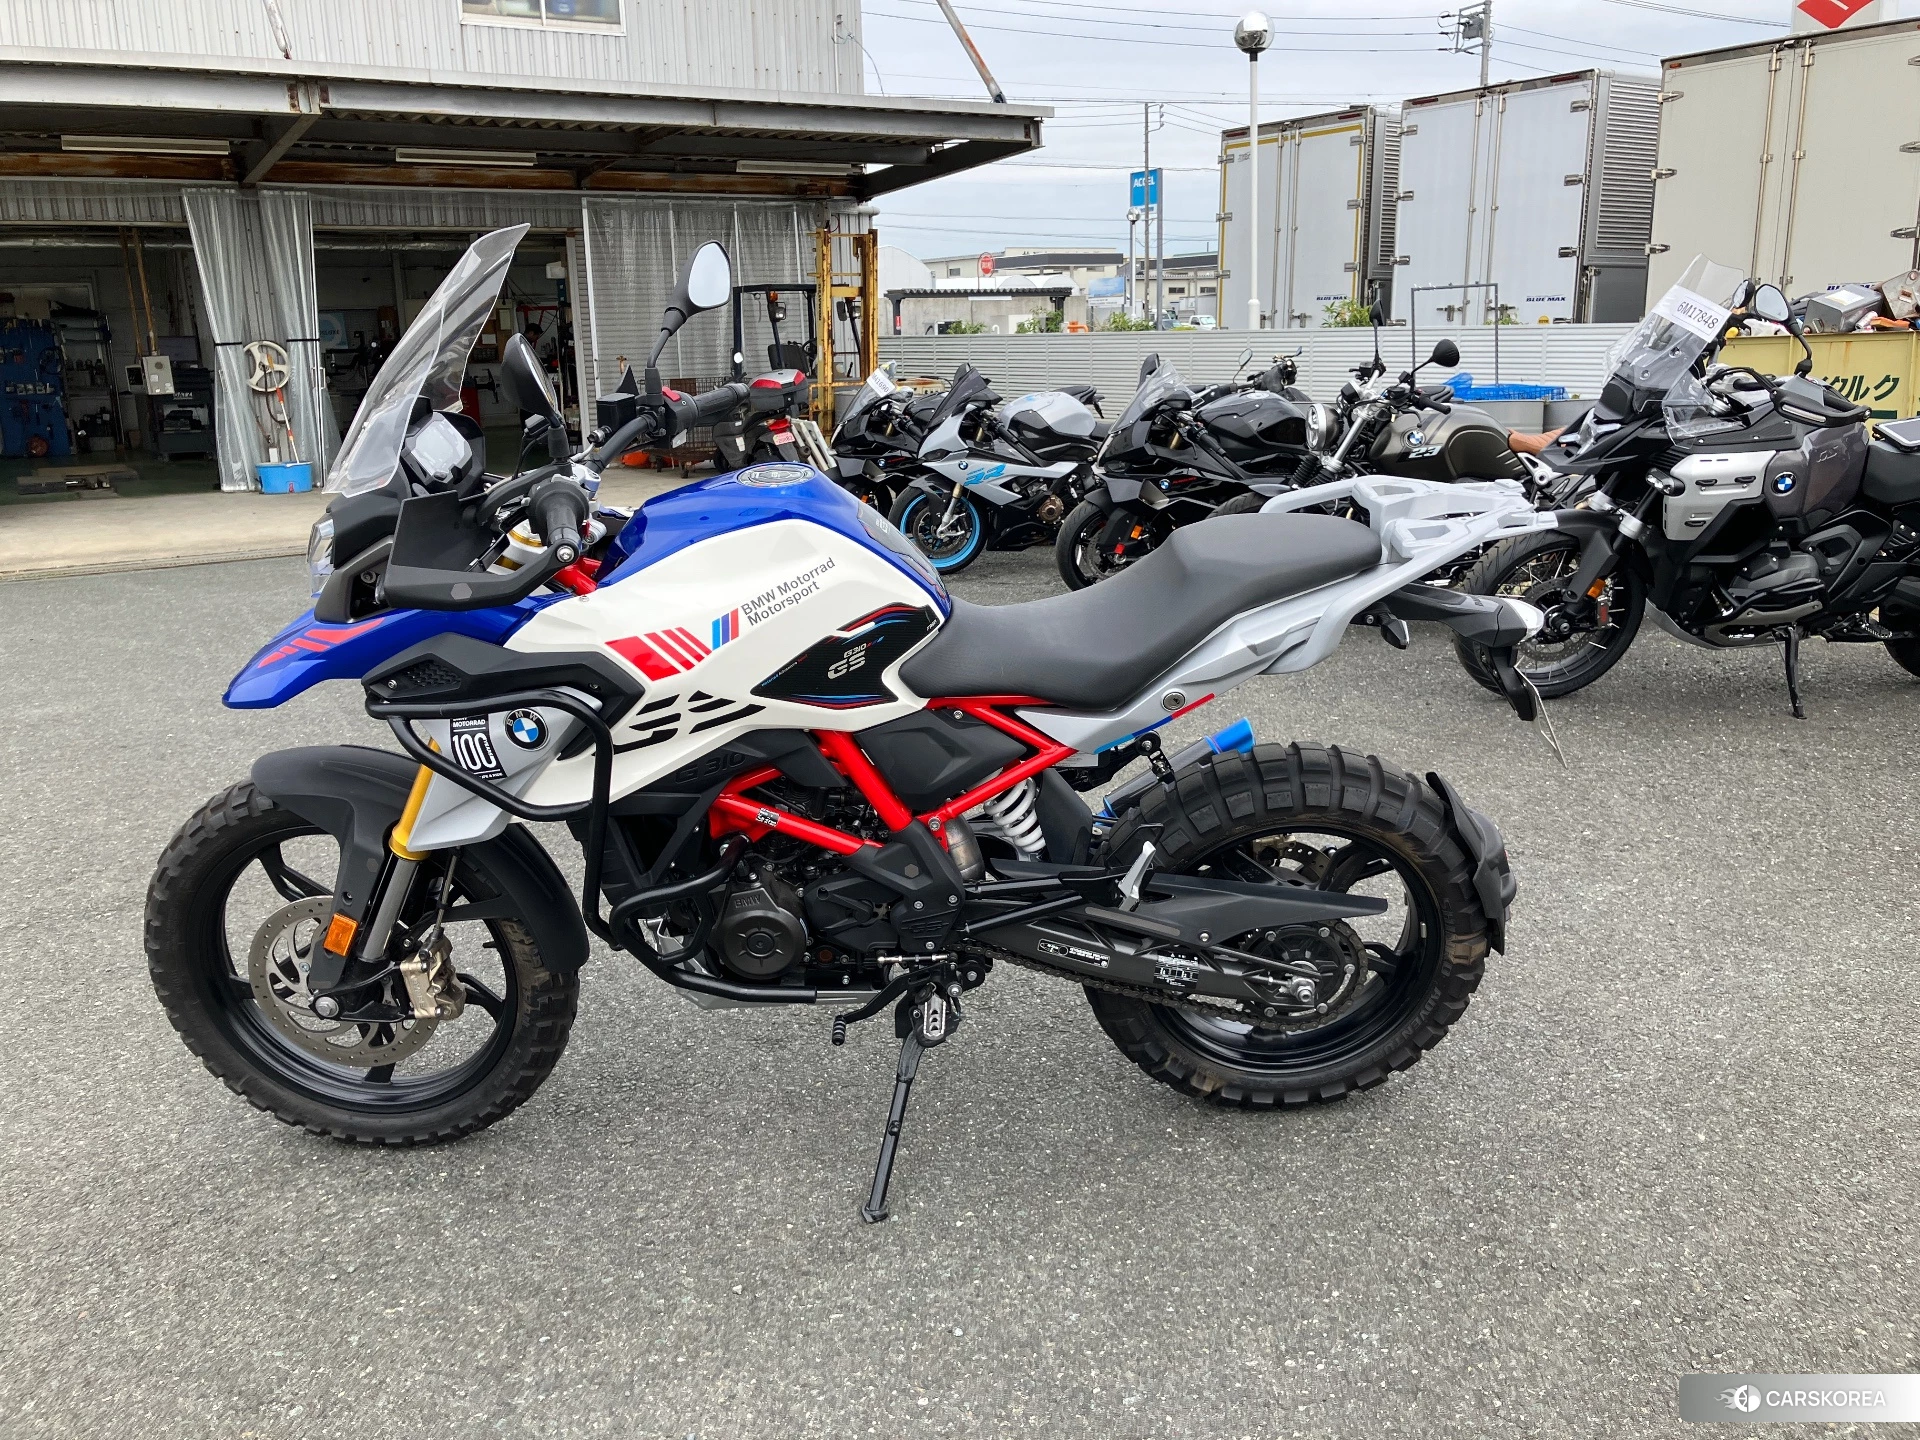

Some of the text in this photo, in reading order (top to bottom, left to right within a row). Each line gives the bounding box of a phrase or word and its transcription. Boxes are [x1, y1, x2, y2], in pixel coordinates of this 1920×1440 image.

[1677, 301, 1719, 329] 6M17848
[1823, 374, 1900, 402] クルク
[740, 556, 836, 616] BMW Motorrad
[747, 580, 820, 627] Motorsport
[452, 719, 486, 728] MOTORRAD
[703, 751, 747, 777] 310
